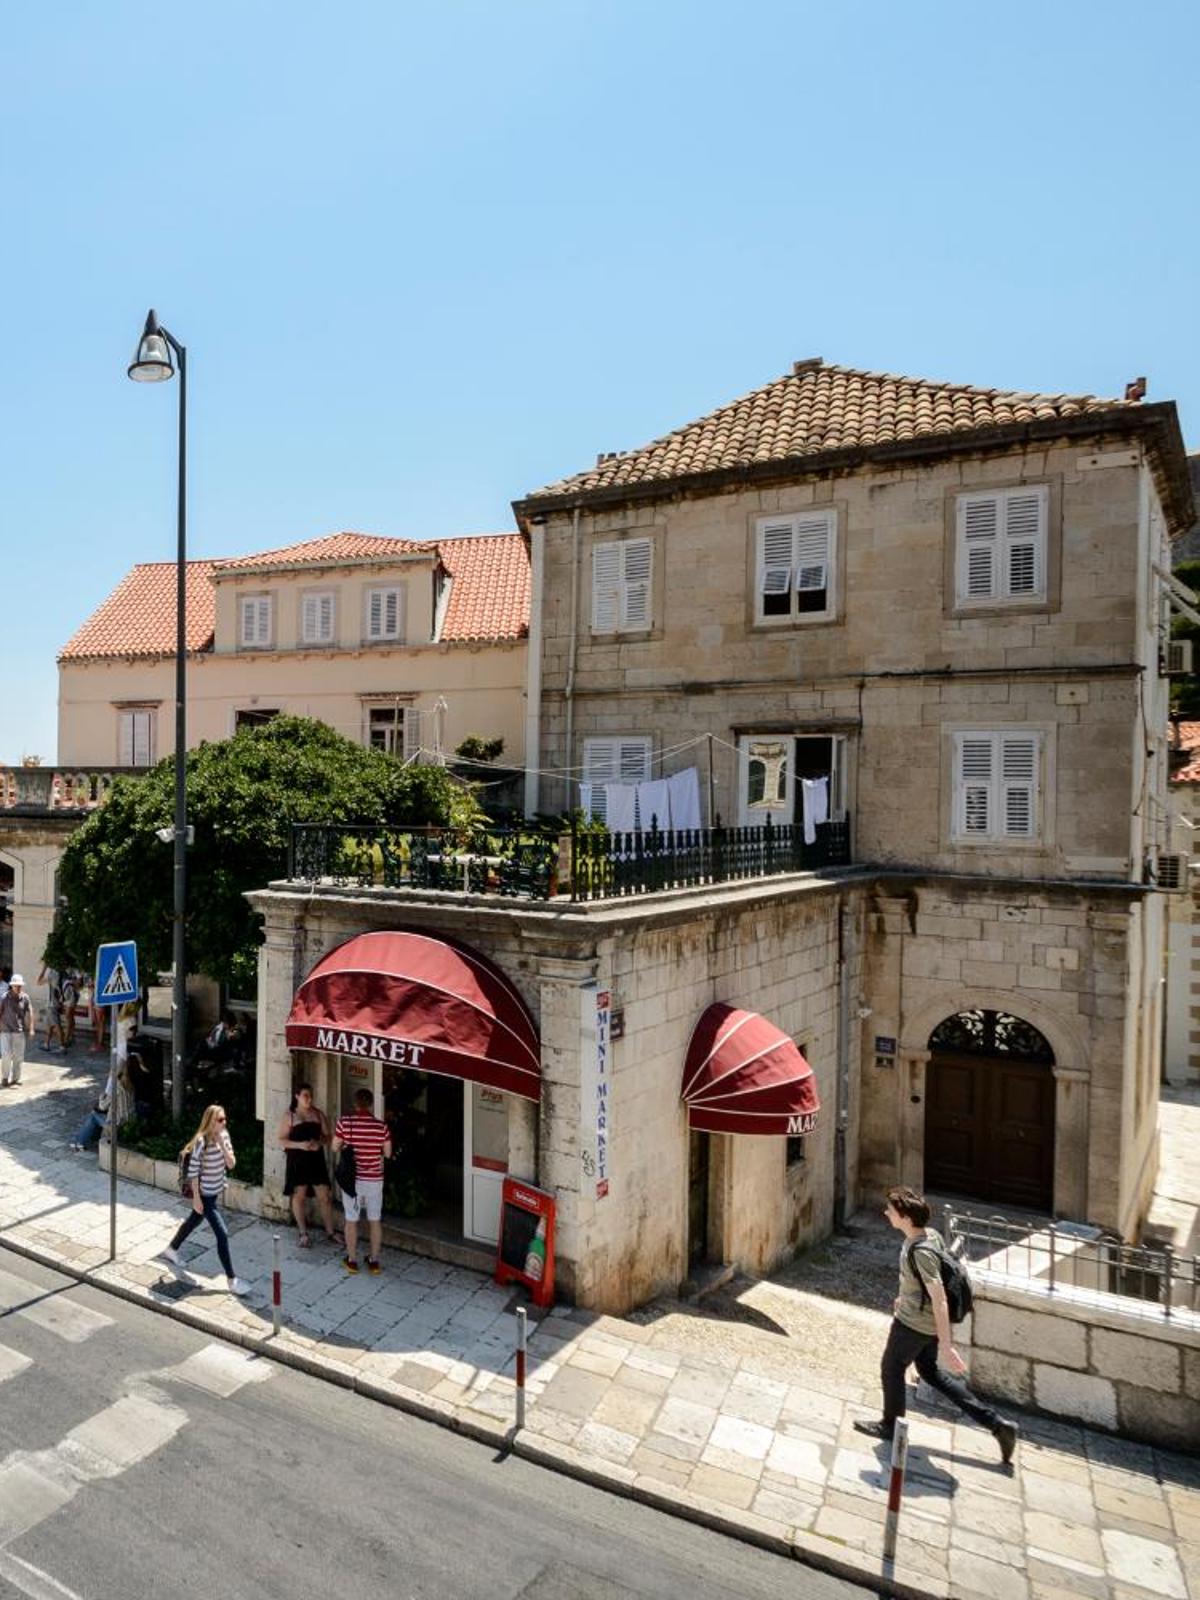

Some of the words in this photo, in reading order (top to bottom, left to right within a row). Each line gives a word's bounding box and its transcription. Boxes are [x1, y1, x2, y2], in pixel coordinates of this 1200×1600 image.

[316, 1028, 425, 1066] MARKET
[597, 1010, 608, 1074] MINI
[596, 1083, 608, 1178] MARKET
